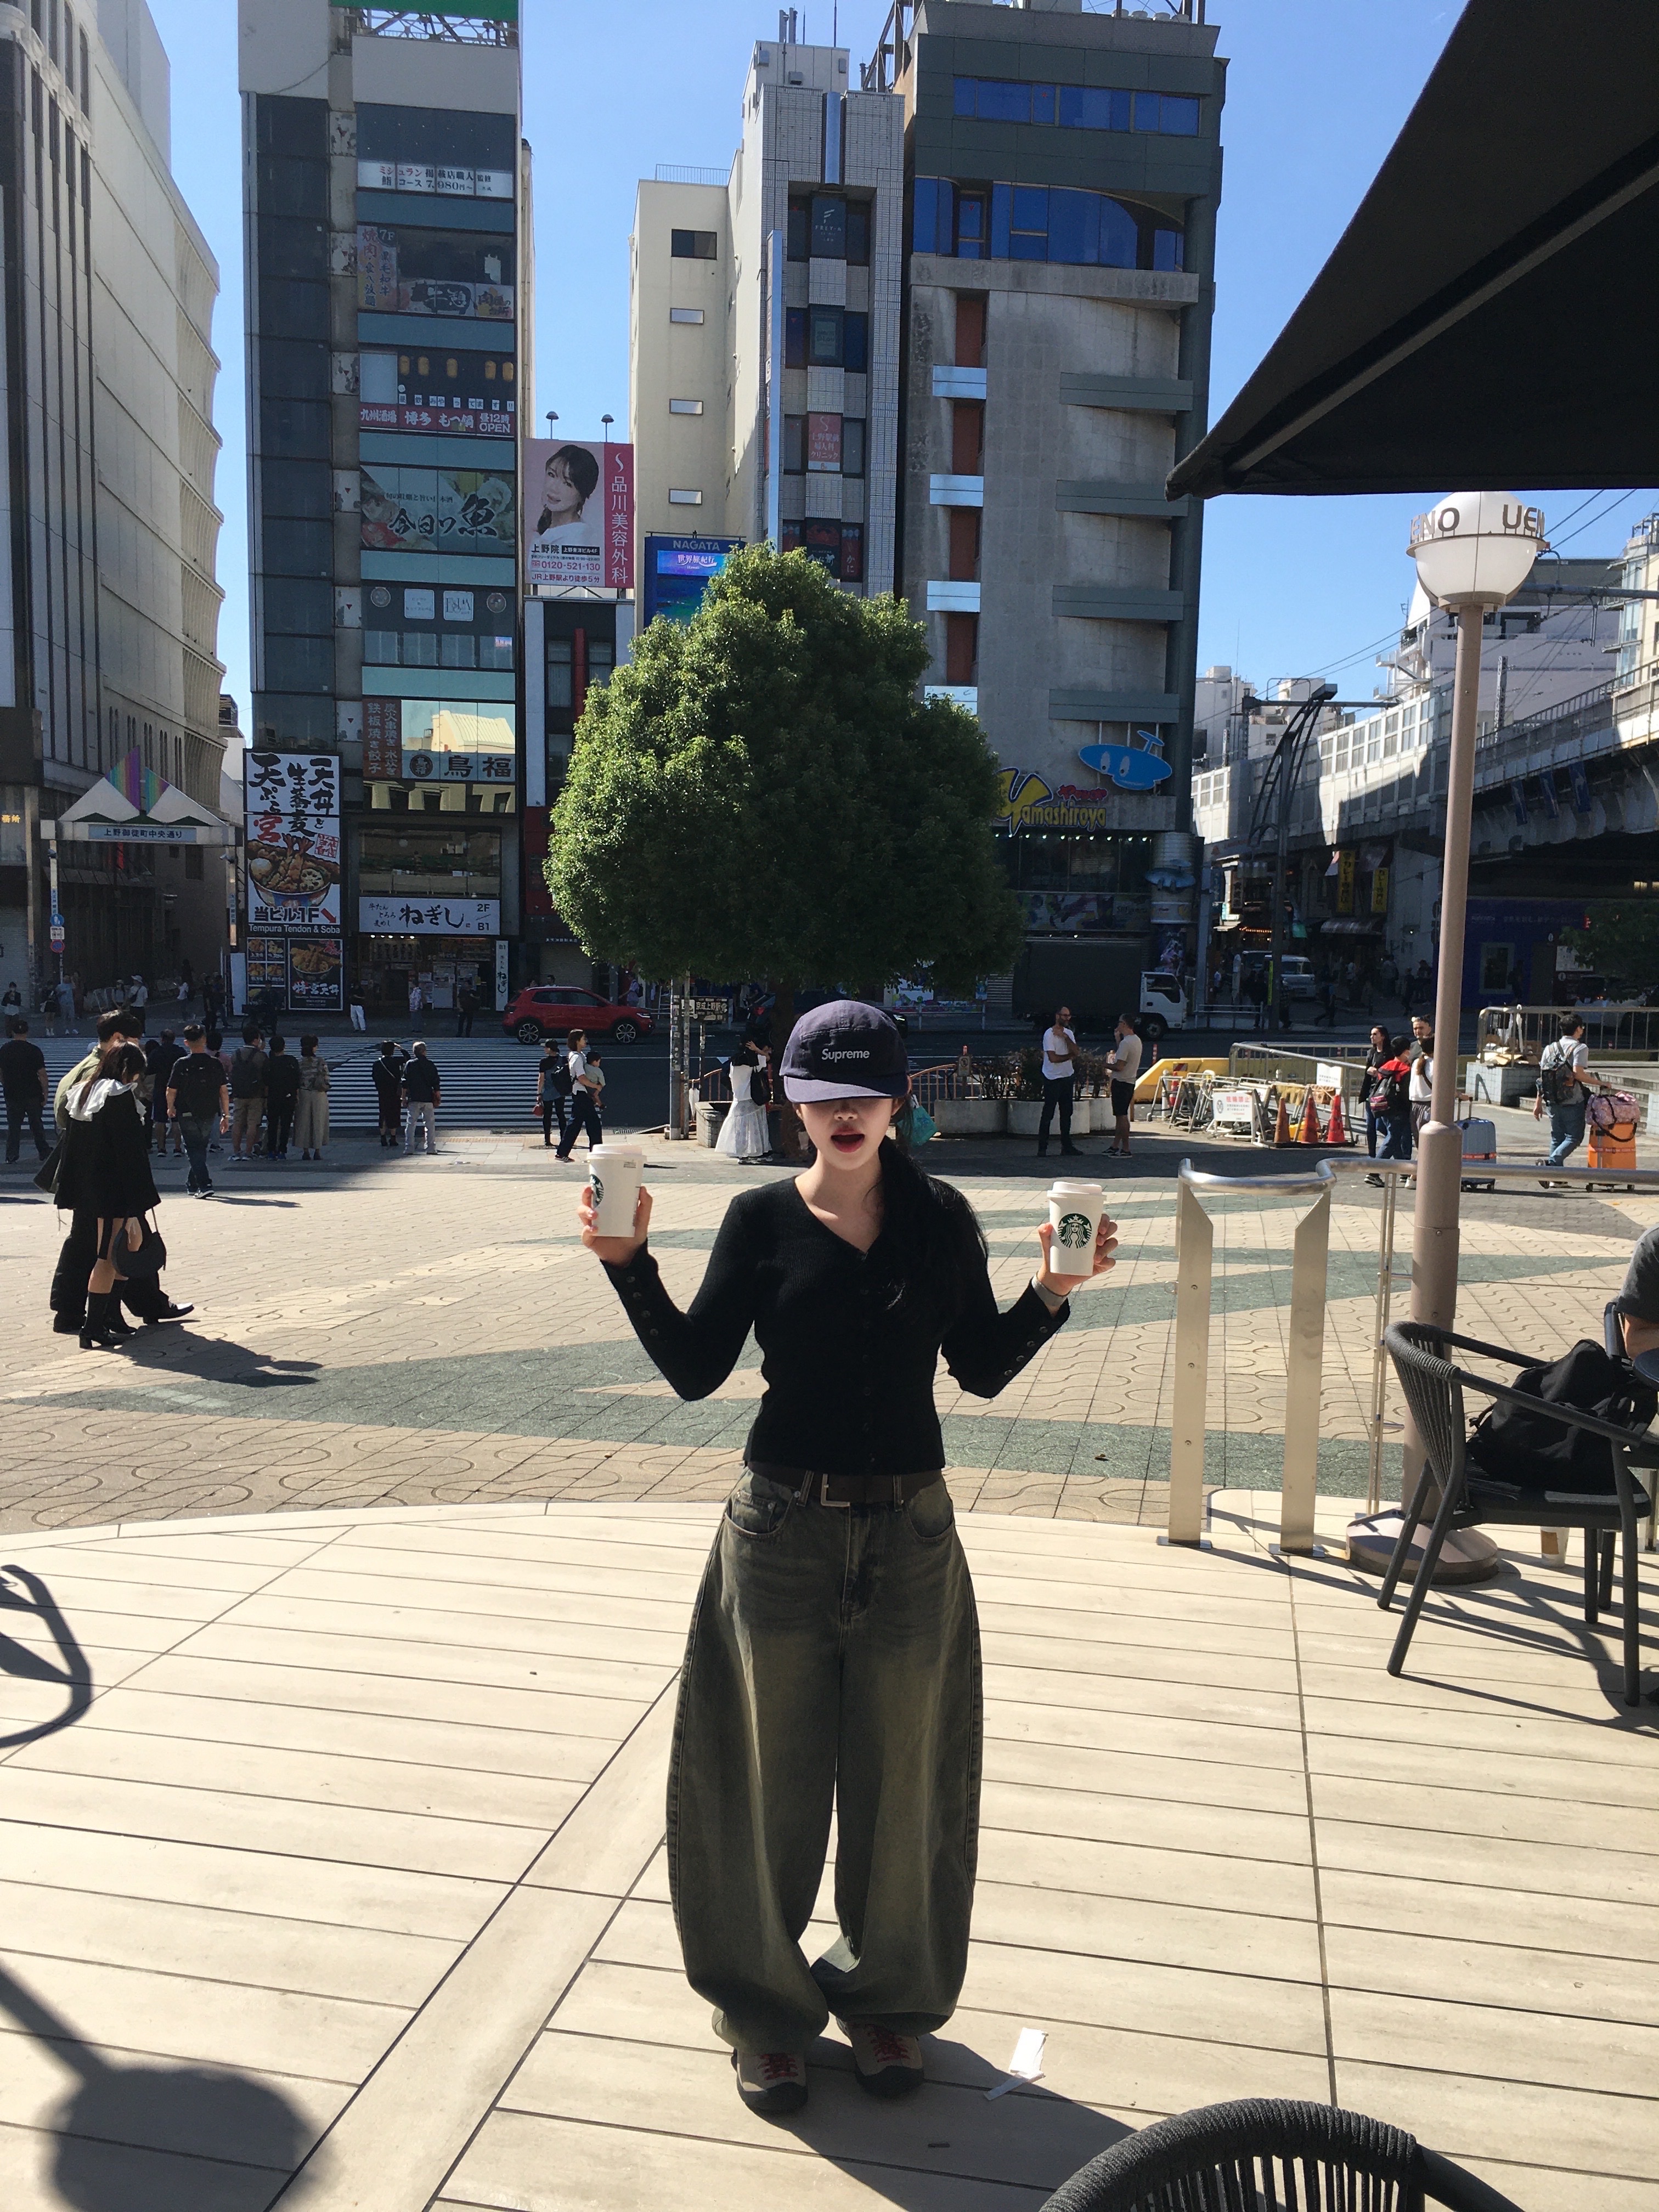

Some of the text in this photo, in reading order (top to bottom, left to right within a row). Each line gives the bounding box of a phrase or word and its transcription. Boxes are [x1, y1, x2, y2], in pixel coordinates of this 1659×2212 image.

[379, 230, 395, 241] 7F
[405, 411, 432, 426] 博多
[479, 423, 511, 433] OPEN
[811, 450, 838, 460] クリニック
[611, 476, 628, 584] 品川美容外科
[531, 544, 560, 555] 上野院
[673, 540, 720, 551] NAGATA
[541, 561, 601, 571] 0120-521-130
[103, 829, 183, 839] 上野御徒町中央通り
[477, 904, 490, 912] 2F
[399, 903, 465, 929] ねぎし
[249, 924, 340, 934] Tempura Tendon & Soba
[477, 922, 490, 931] B1
[821, 1048, 870, 1063] Supreme
